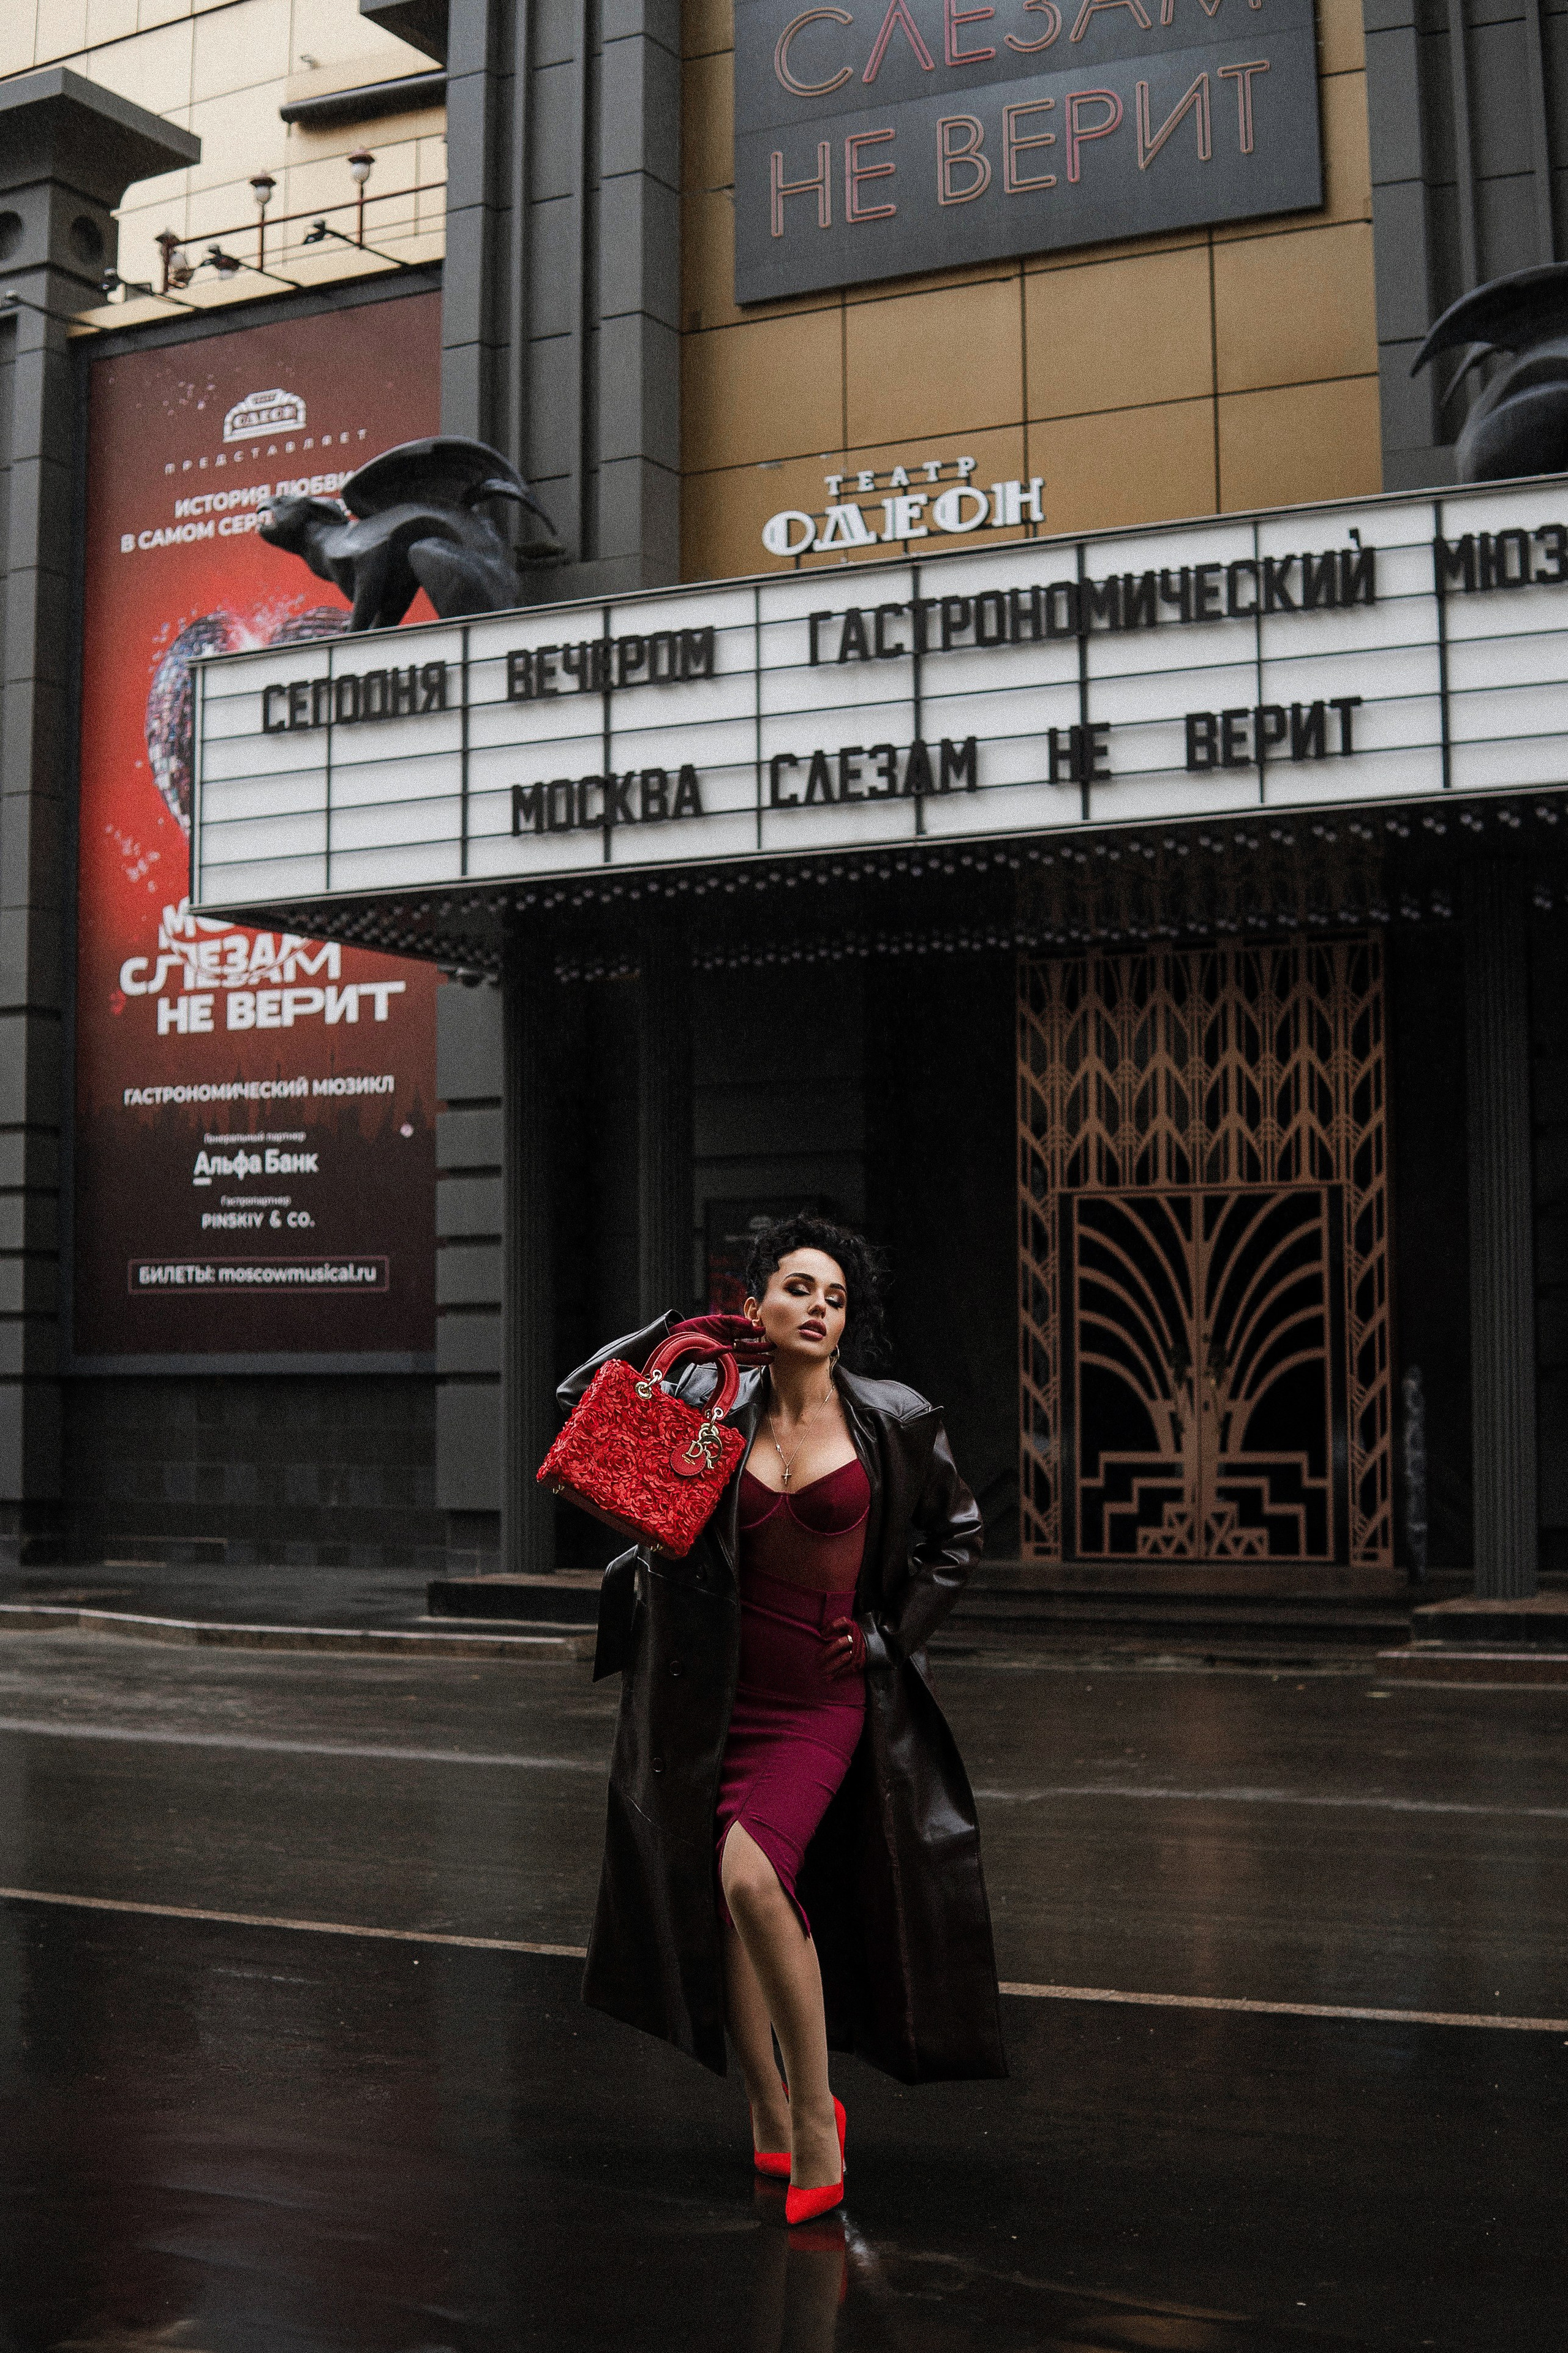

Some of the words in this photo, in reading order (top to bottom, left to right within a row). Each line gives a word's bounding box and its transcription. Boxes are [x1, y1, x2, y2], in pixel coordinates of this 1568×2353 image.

[774, 0, 1263, 97] СЛЕЗ
[771, 128, 896, 238] НЕ
[936, 60, 1270, 206] ВЕРИТ
[164, 429, 367, 475] ПРЕДСТАВЛЯЕТ
[824, 456, 976, 496] ТЕАТР
[175, 483, 271, 519] ИСТОРИЯ
[762, 477, 1045, 556] ОДЕОН
[121, 534, 135, 554] В
[138, 519, 215, 551] САМОМ
[263, 661, 446, 734] СЕГОДНЯ
[507, 626, 714, 702] ВЕЧЕРОМ
[809, 529, 1376, 667] ГАСТРОНОМИЧЕСКИЙ
[512, 764, 704, 837] МОСКВА
[769, 736, 978, 809] СЛЕЗАМ
[1048, 722, 1111, 784] НЕ
[1185, 696, 1363, 771] ВЕРИТ
[119, 932, 342, 996] СЛЕЗАМ
[157, 993, 214, 1035] НЕ
[227, 980, 406, 1031] ВЕРИТ
[124, 1076, 309, 1106] ГАСТРОНОМИЧЕСКИЙ
[312, 1075, 395, 1097] МЮЗИКЛ
[194, 1149, 262, 1180] Альфа
[265, 1148, 319, 1174] Банк
[270, 1209, 282, 1228] &
[219, 1263, 377, 1283] moscowmusical.ru
